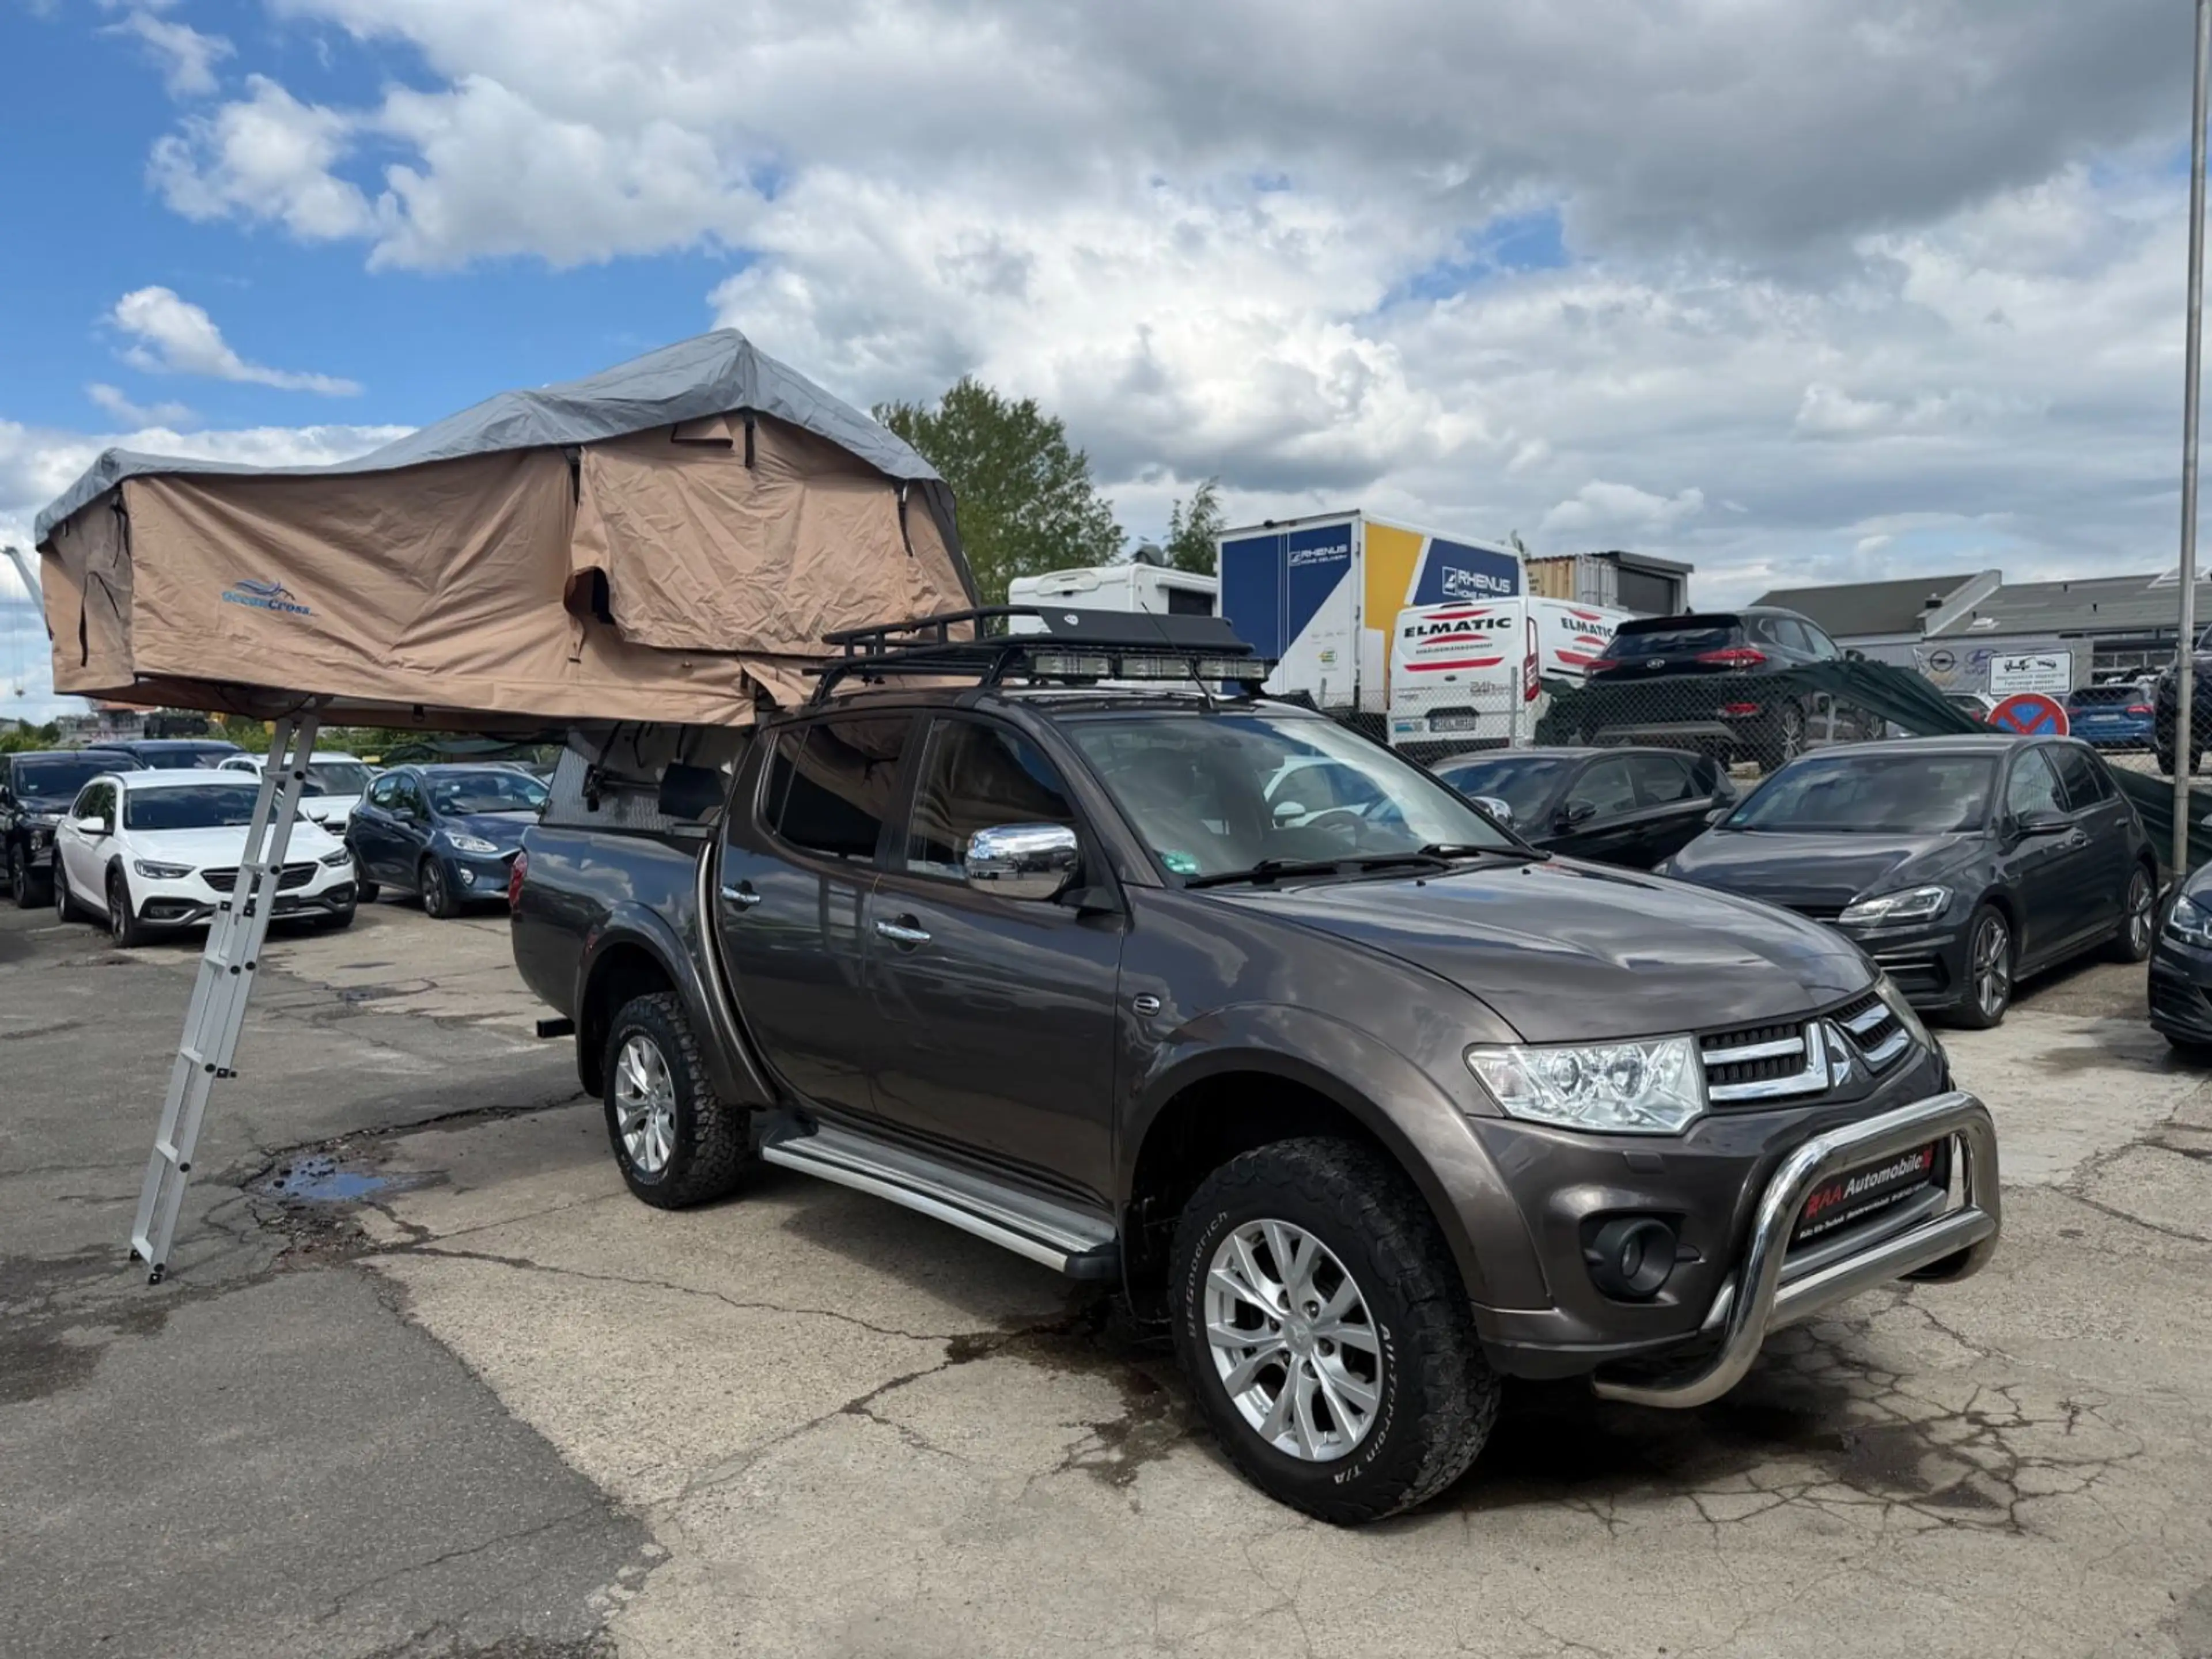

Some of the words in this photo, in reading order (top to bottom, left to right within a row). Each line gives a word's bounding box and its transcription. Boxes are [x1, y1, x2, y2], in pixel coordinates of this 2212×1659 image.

[1301, 544, 1348, 558] RHENUS
[1457, 569, 1511, 594] RHENUS
[1404, 618, 1512, 638] ELMATIC
[1843, 1153, 1923, 1199] Automobile
[1334, 1465, 1363, 1484] T/A
